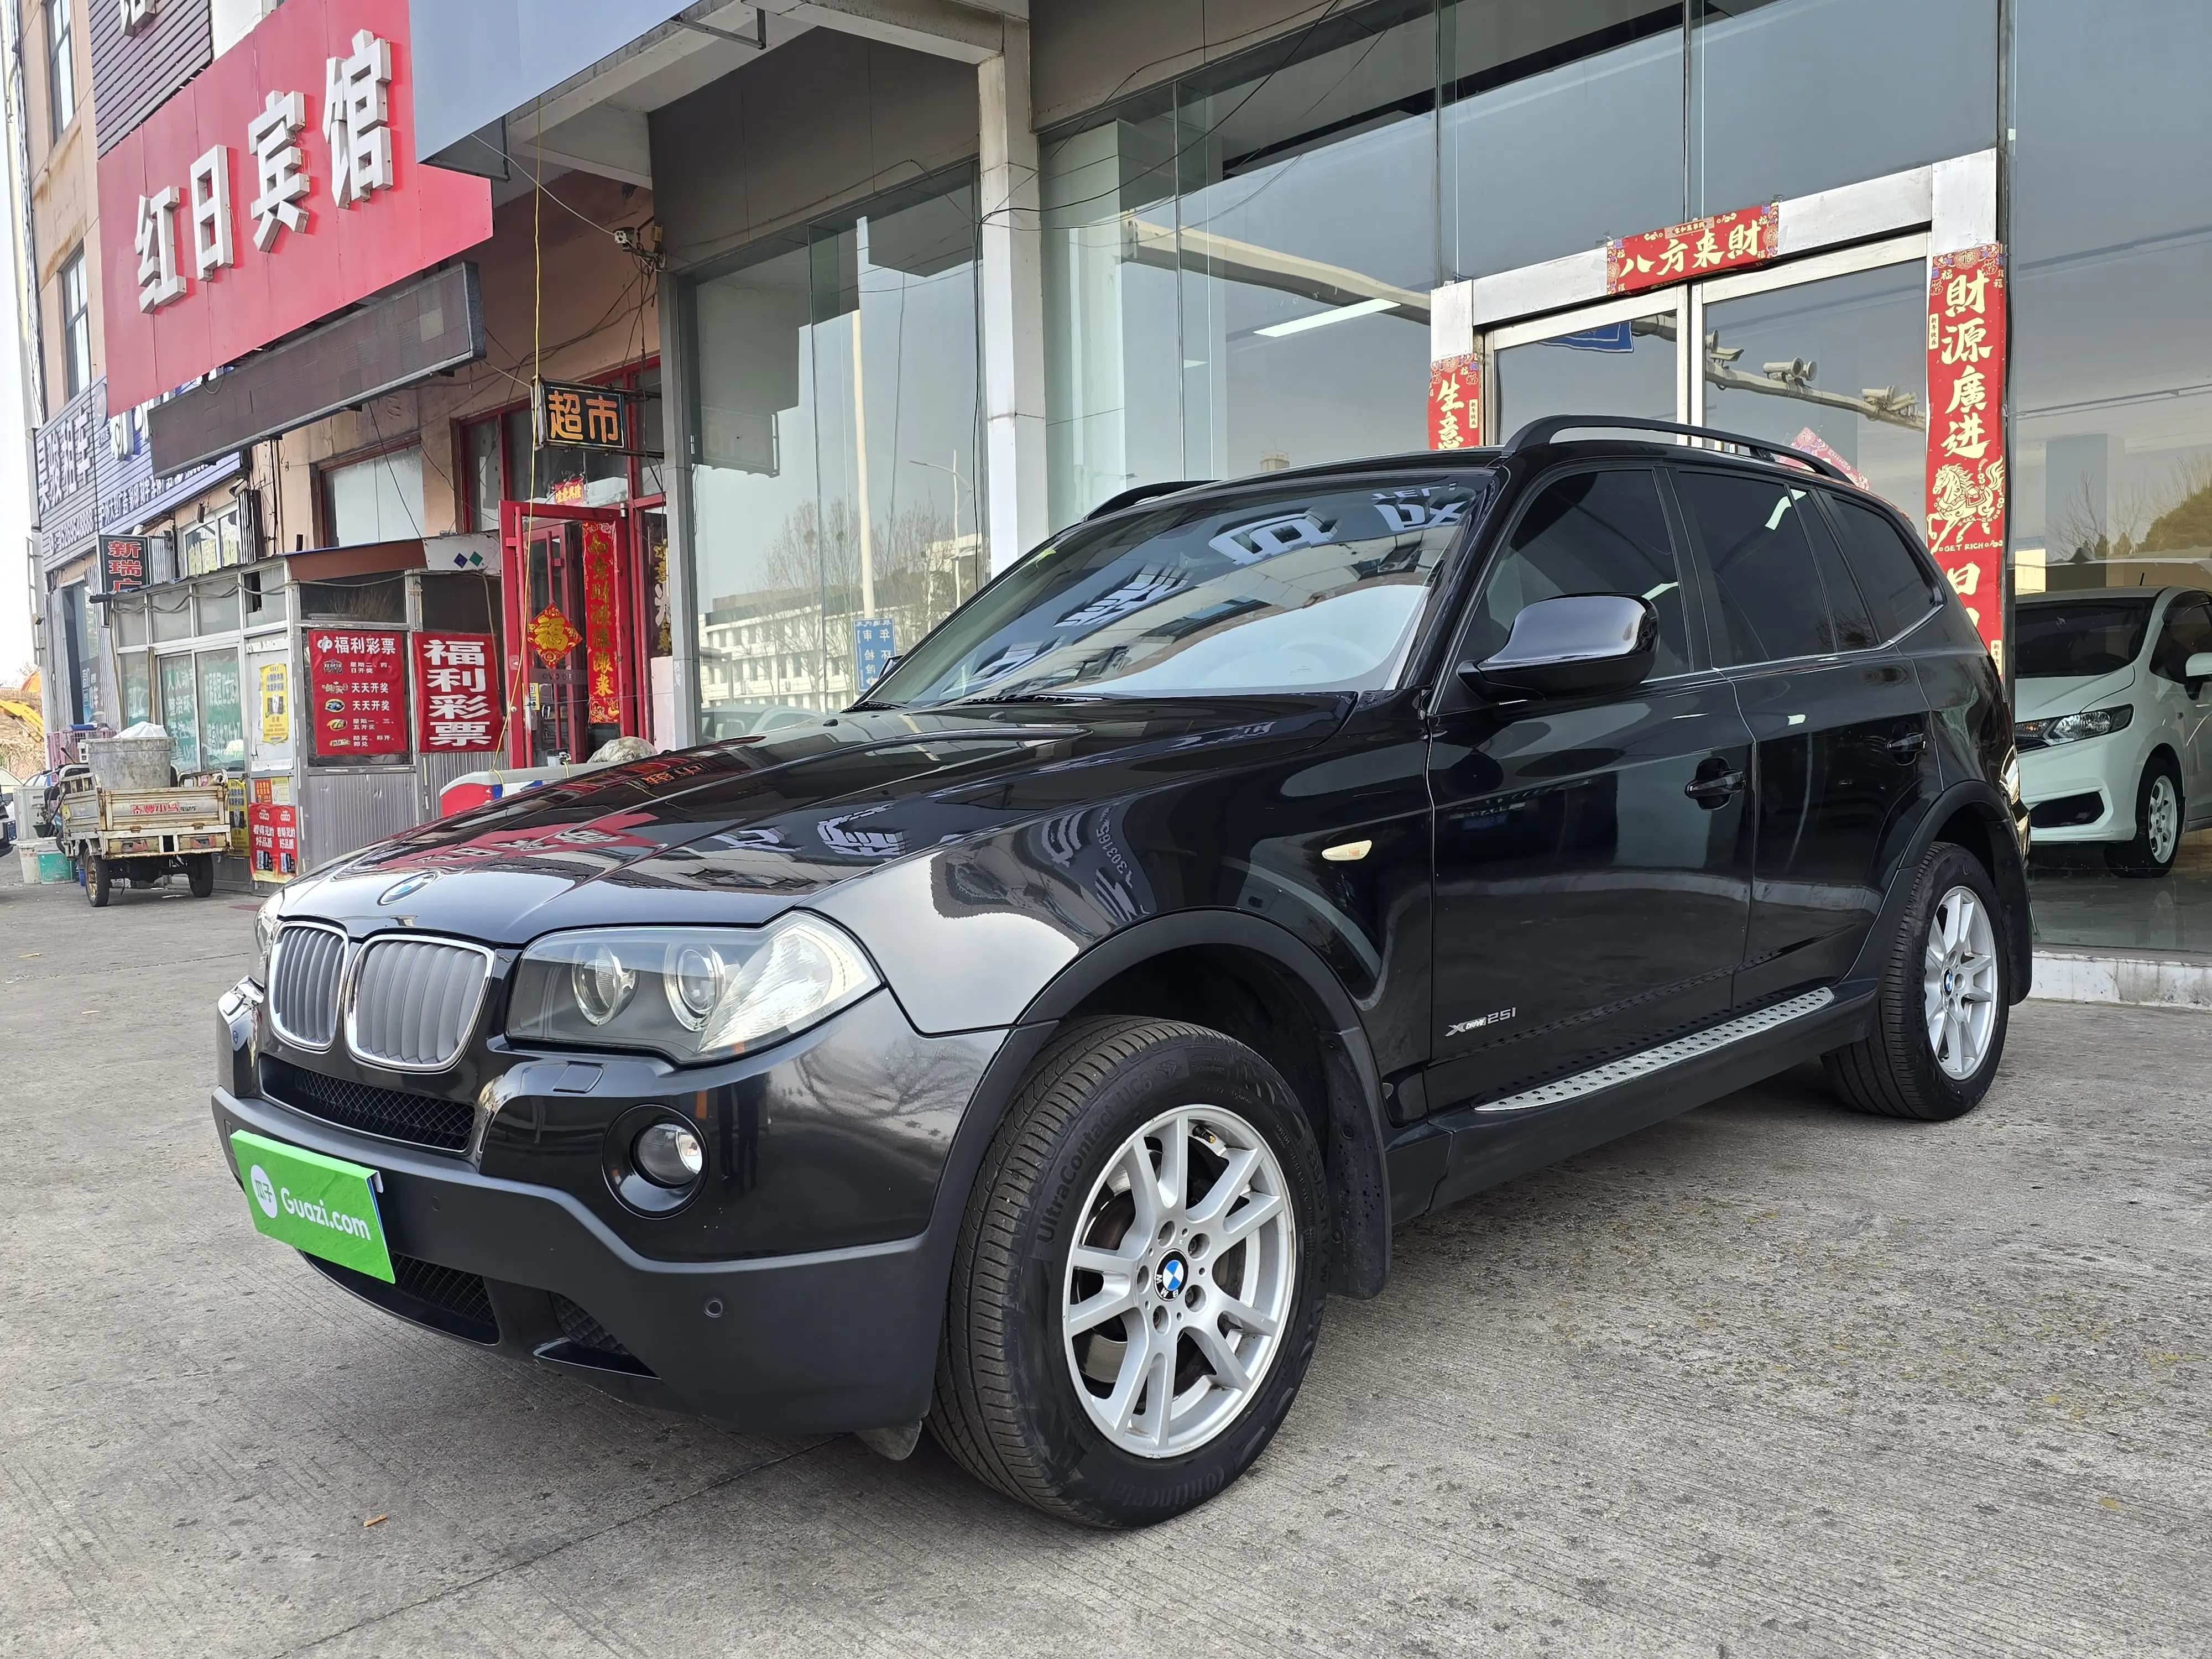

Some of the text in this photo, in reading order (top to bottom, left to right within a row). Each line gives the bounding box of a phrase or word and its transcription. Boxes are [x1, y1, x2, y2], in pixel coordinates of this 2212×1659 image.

[135, 29, 393, 314] 红日宾馆
[548, 389, 618, 444] 超市
[1436, 373, 1465, 449] 生意
[1944, 542, 1984, 552] GET RICH
[335, 636, 396, 655] 福利彩票
[534, 614, 568, 651] 福
[351, 682, 389, 693] 天天开奖
[424, 639, 492, 746] 福利彩票
[352, 700, 390, 711] 天天开奖
[255, 837, 273, 849] 好品质
[279, 838, 294, 849] 好品质
[281, 1187, 371, 1241] Guazi.com
